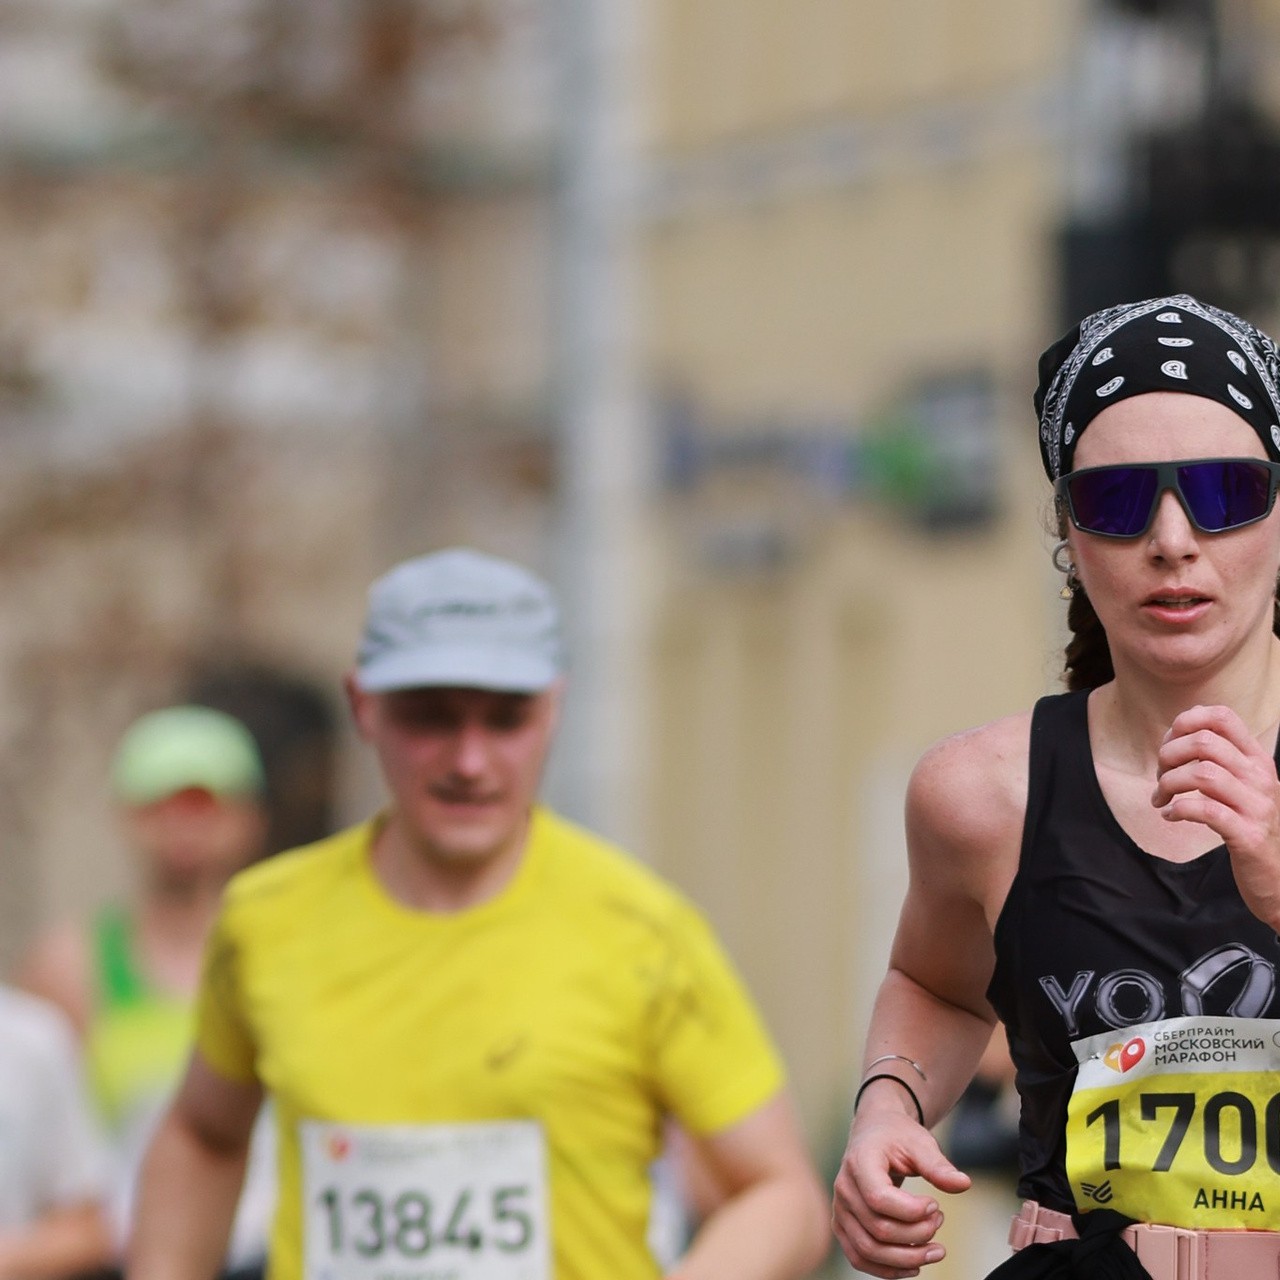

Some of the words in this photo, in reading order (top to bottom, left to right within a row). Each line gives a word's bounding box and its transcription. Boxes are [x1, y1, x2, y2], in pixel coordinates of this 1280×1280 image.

[1154, 1026, 1235, 1042] СБЕРПРАЙМ
[1154, 1037, 1265, 1055] МОСКОВСКИЙ
[1154, 1051, 1236, 1066] МАРАФОН
[1193, 1188, 1266, 1212] АННА
[316, 1185, 535, 1260] 13845
